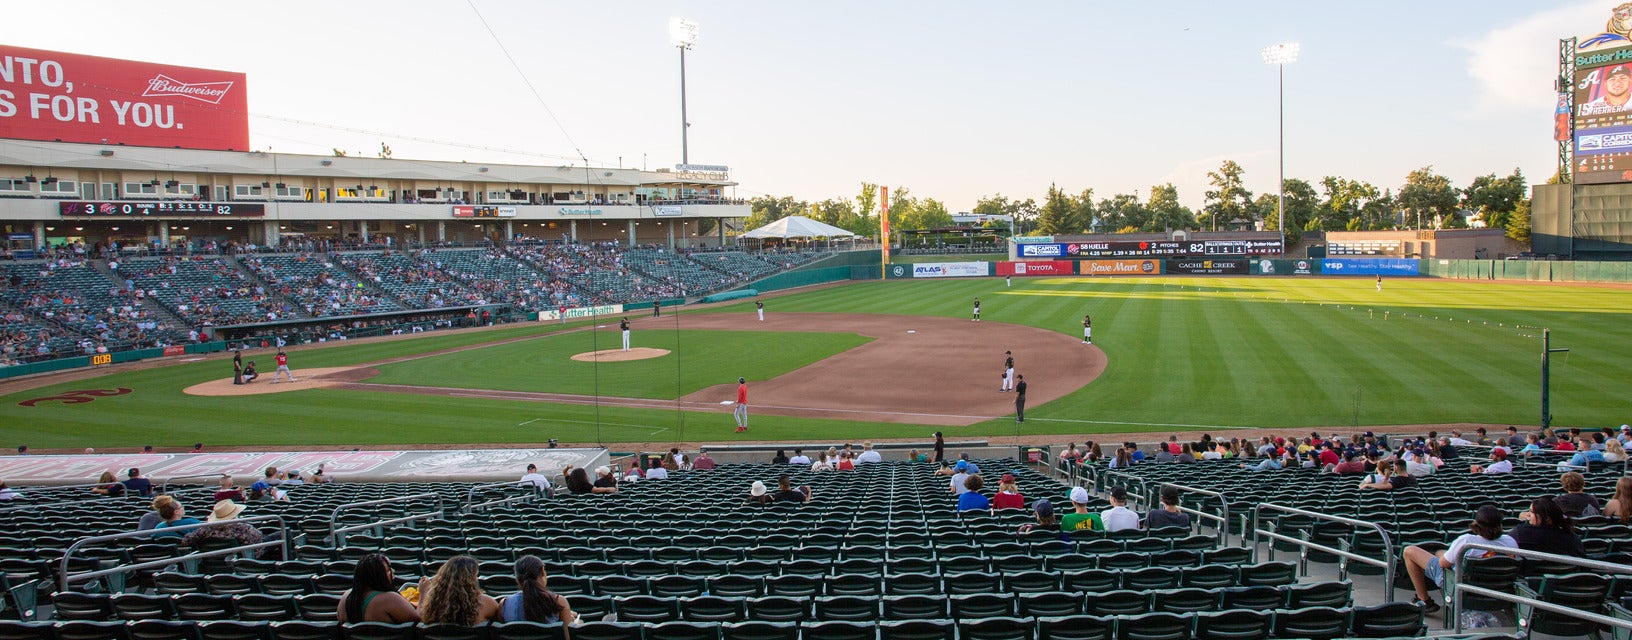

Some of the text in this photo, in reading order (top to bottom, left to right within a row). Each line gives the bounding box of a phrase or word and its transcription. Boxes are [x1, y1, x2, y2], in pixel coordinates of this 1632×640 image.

[1576, 53, 1615, 66] Sutter
[149, 78, 224, 96] Budweiser
[29, 93, 100, 124] FOR
[110, 100, 184, 130] YOU.
[1592, 105, 1627, 115] HERRERA
[85, 204, 95, 214] 3
[123, 204, 132, 214] 0
[217, 206, 231, 214] 82
[1190, 244, 1204, 252] 82
[1091, 263, 1112, 272] Save
[1113, 262, 1138, 271] Mart
[560, 306, 614, 319] utter Health
